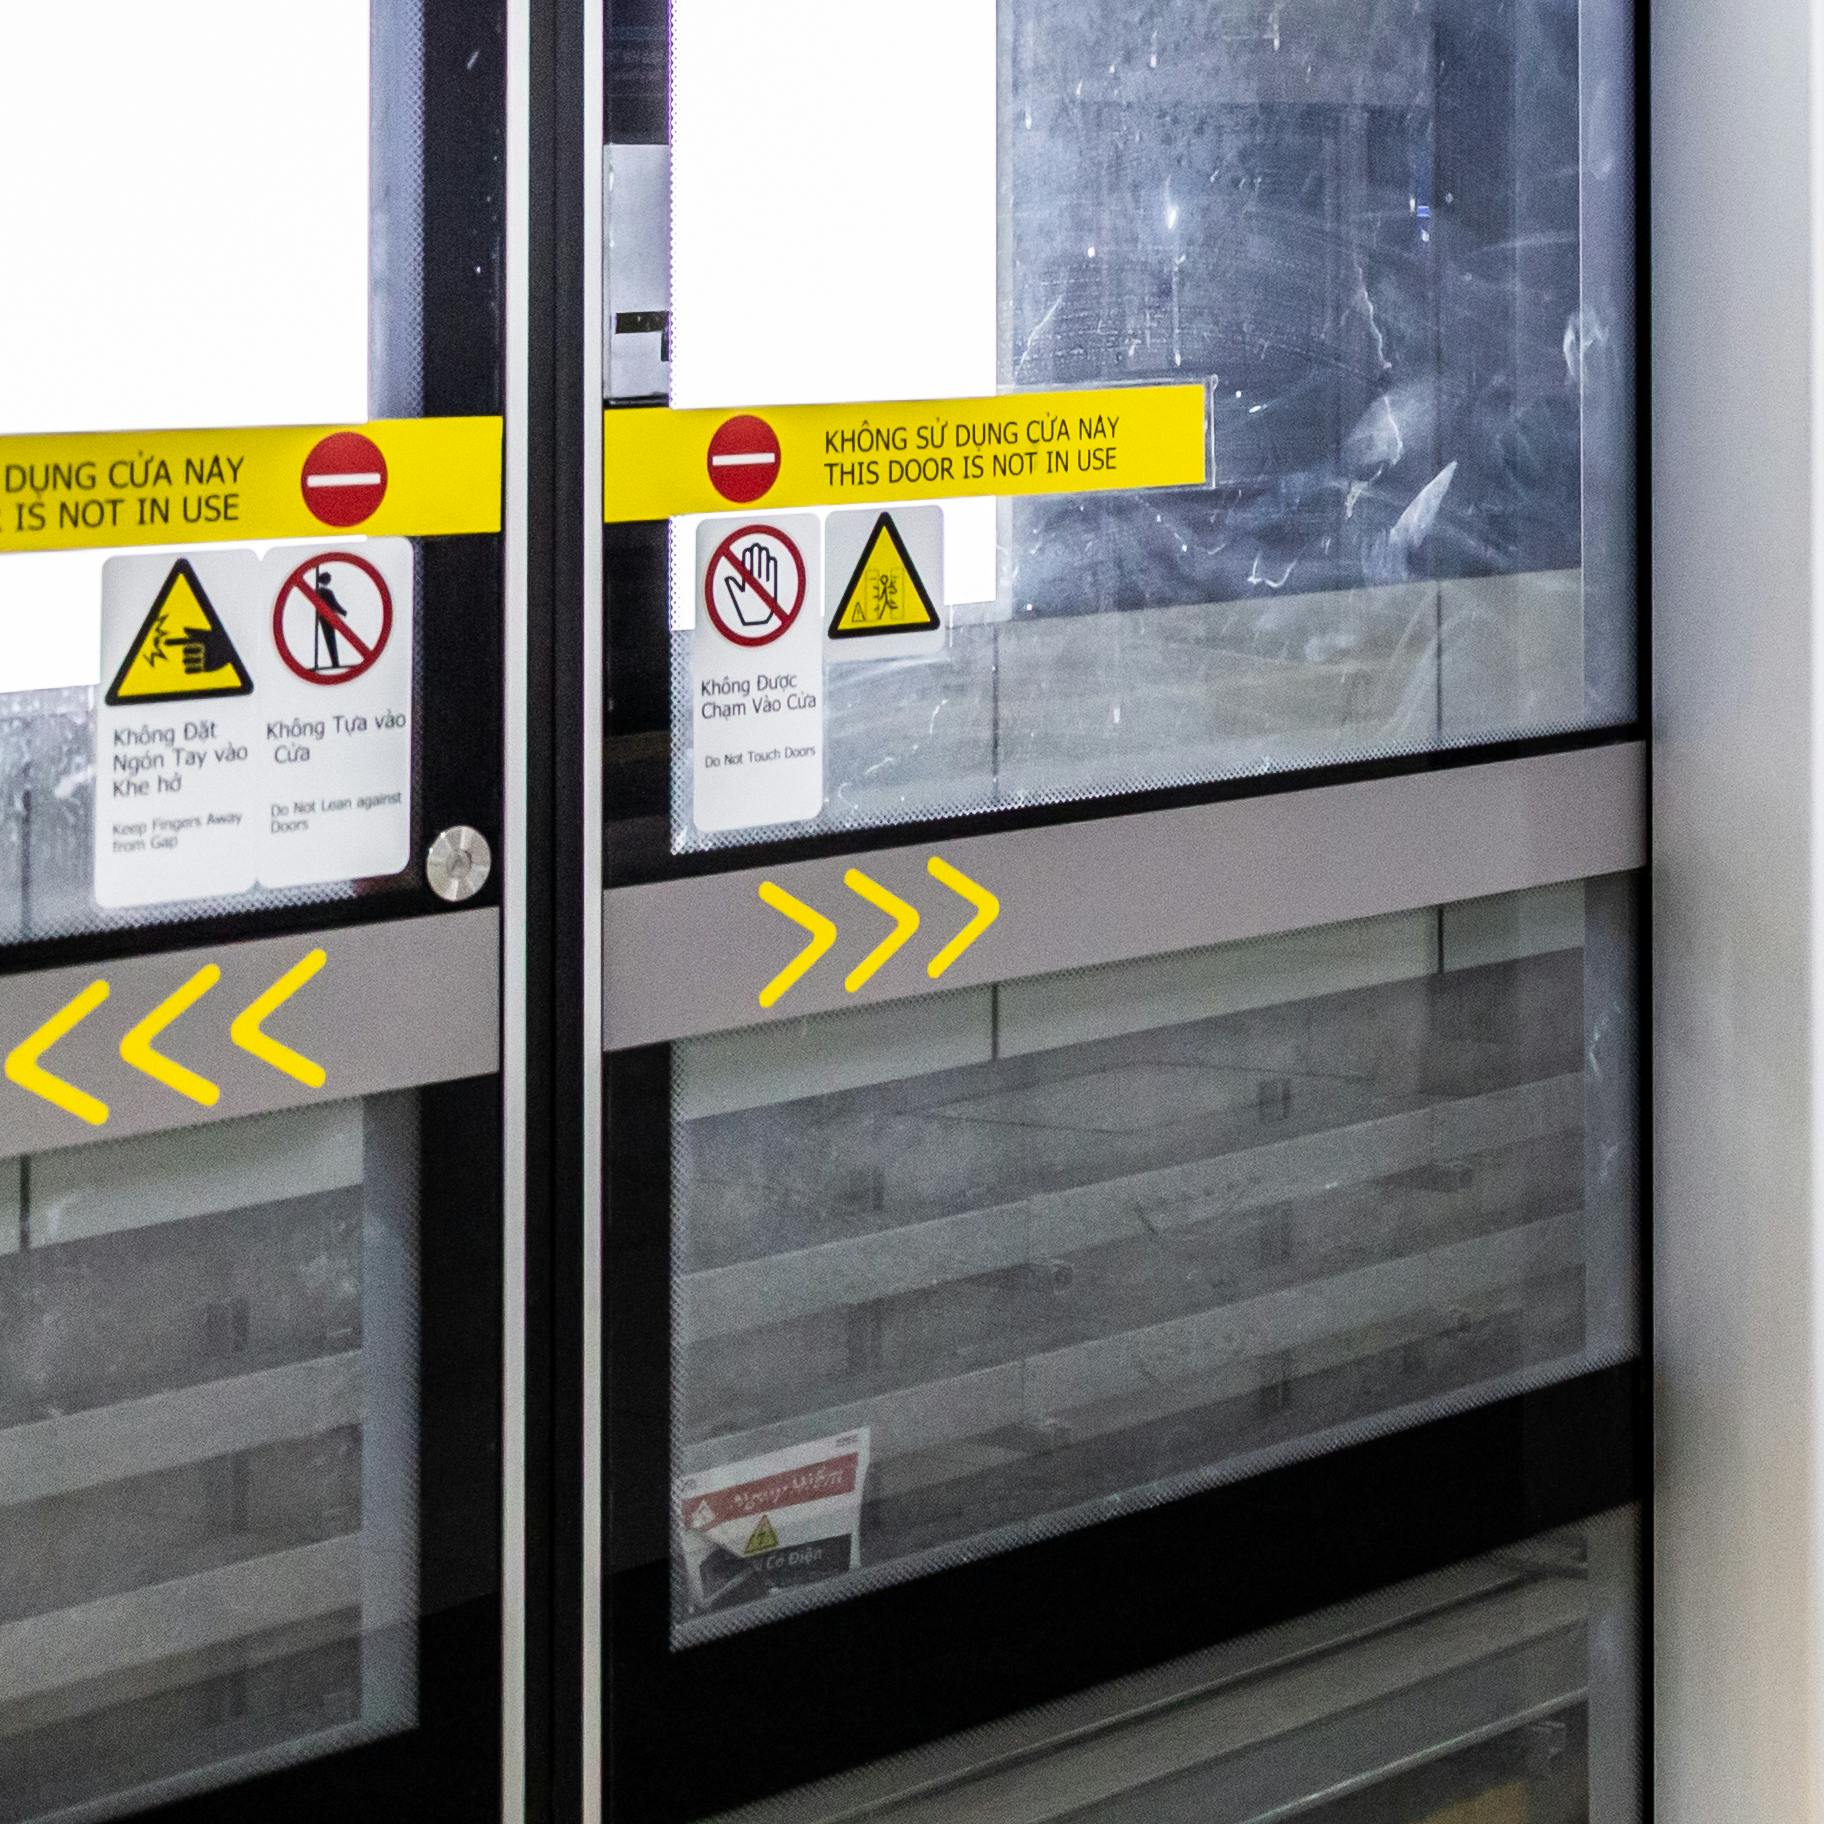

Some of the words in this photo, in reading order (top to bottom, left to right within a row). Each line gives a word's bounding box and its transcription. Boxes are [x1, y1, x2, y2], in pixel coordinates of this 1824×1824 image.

[825, 419, 908, 454] KHÔNG
[916, 416, 948, 449] SỬ
[955, 420, 1018, 453] DỤNG
[1026, 412, 1070, 444] CỬA
[4, 460, 97, 501] DỤNG
[108, 448, 172, 490] CỬA
[824, 460, 880, 486] THIS
[888, 457, 955, 484] DOOR
[963, 455, 984, 479] IS
[992, 451, 1038, 477] NOT
[1046, 450, 1069, 474] IN
[1077, 447, 1117, 472] USE
[16, 500, 47, 532] IS
[59, 498, 125, 530] NOT
[137, 496, 170, 526] IN
[182, 493, 240, 523] USE
[701, 674, 751, 697] Không
[756, 673, 798, 693] Được
[701, 701, 747, 722] Chạm
[752, 694, 782, 714] Vào
[786, 690, 817, 710] Cửa
[113, 724, 176, 747] Không
[266, 716, 326, 740] Không
[374, 708, 407, 729] vào
[113, 750, 165, 775] Ngón
[172, 747, 208, 769] Tay
[213, 741, 249, 763] vào
[274, 741, 311, 764] Cửa
[705, 755, 721, 769] Do
[723, 752, 744, 766] Not
[748, 748, 781, 763] Touch
[784, 745, 816, 759] Doors
[112, 779, 150, 798] Khe
[271, 803, 290, 817] Do
[293, 800, 316, 814] Not
[321, 798, 352, 813] Lean
[356, 791, 402, 811] against
[206, 812, 243, 826] Away
[271, 819, 309, 835] Doors
